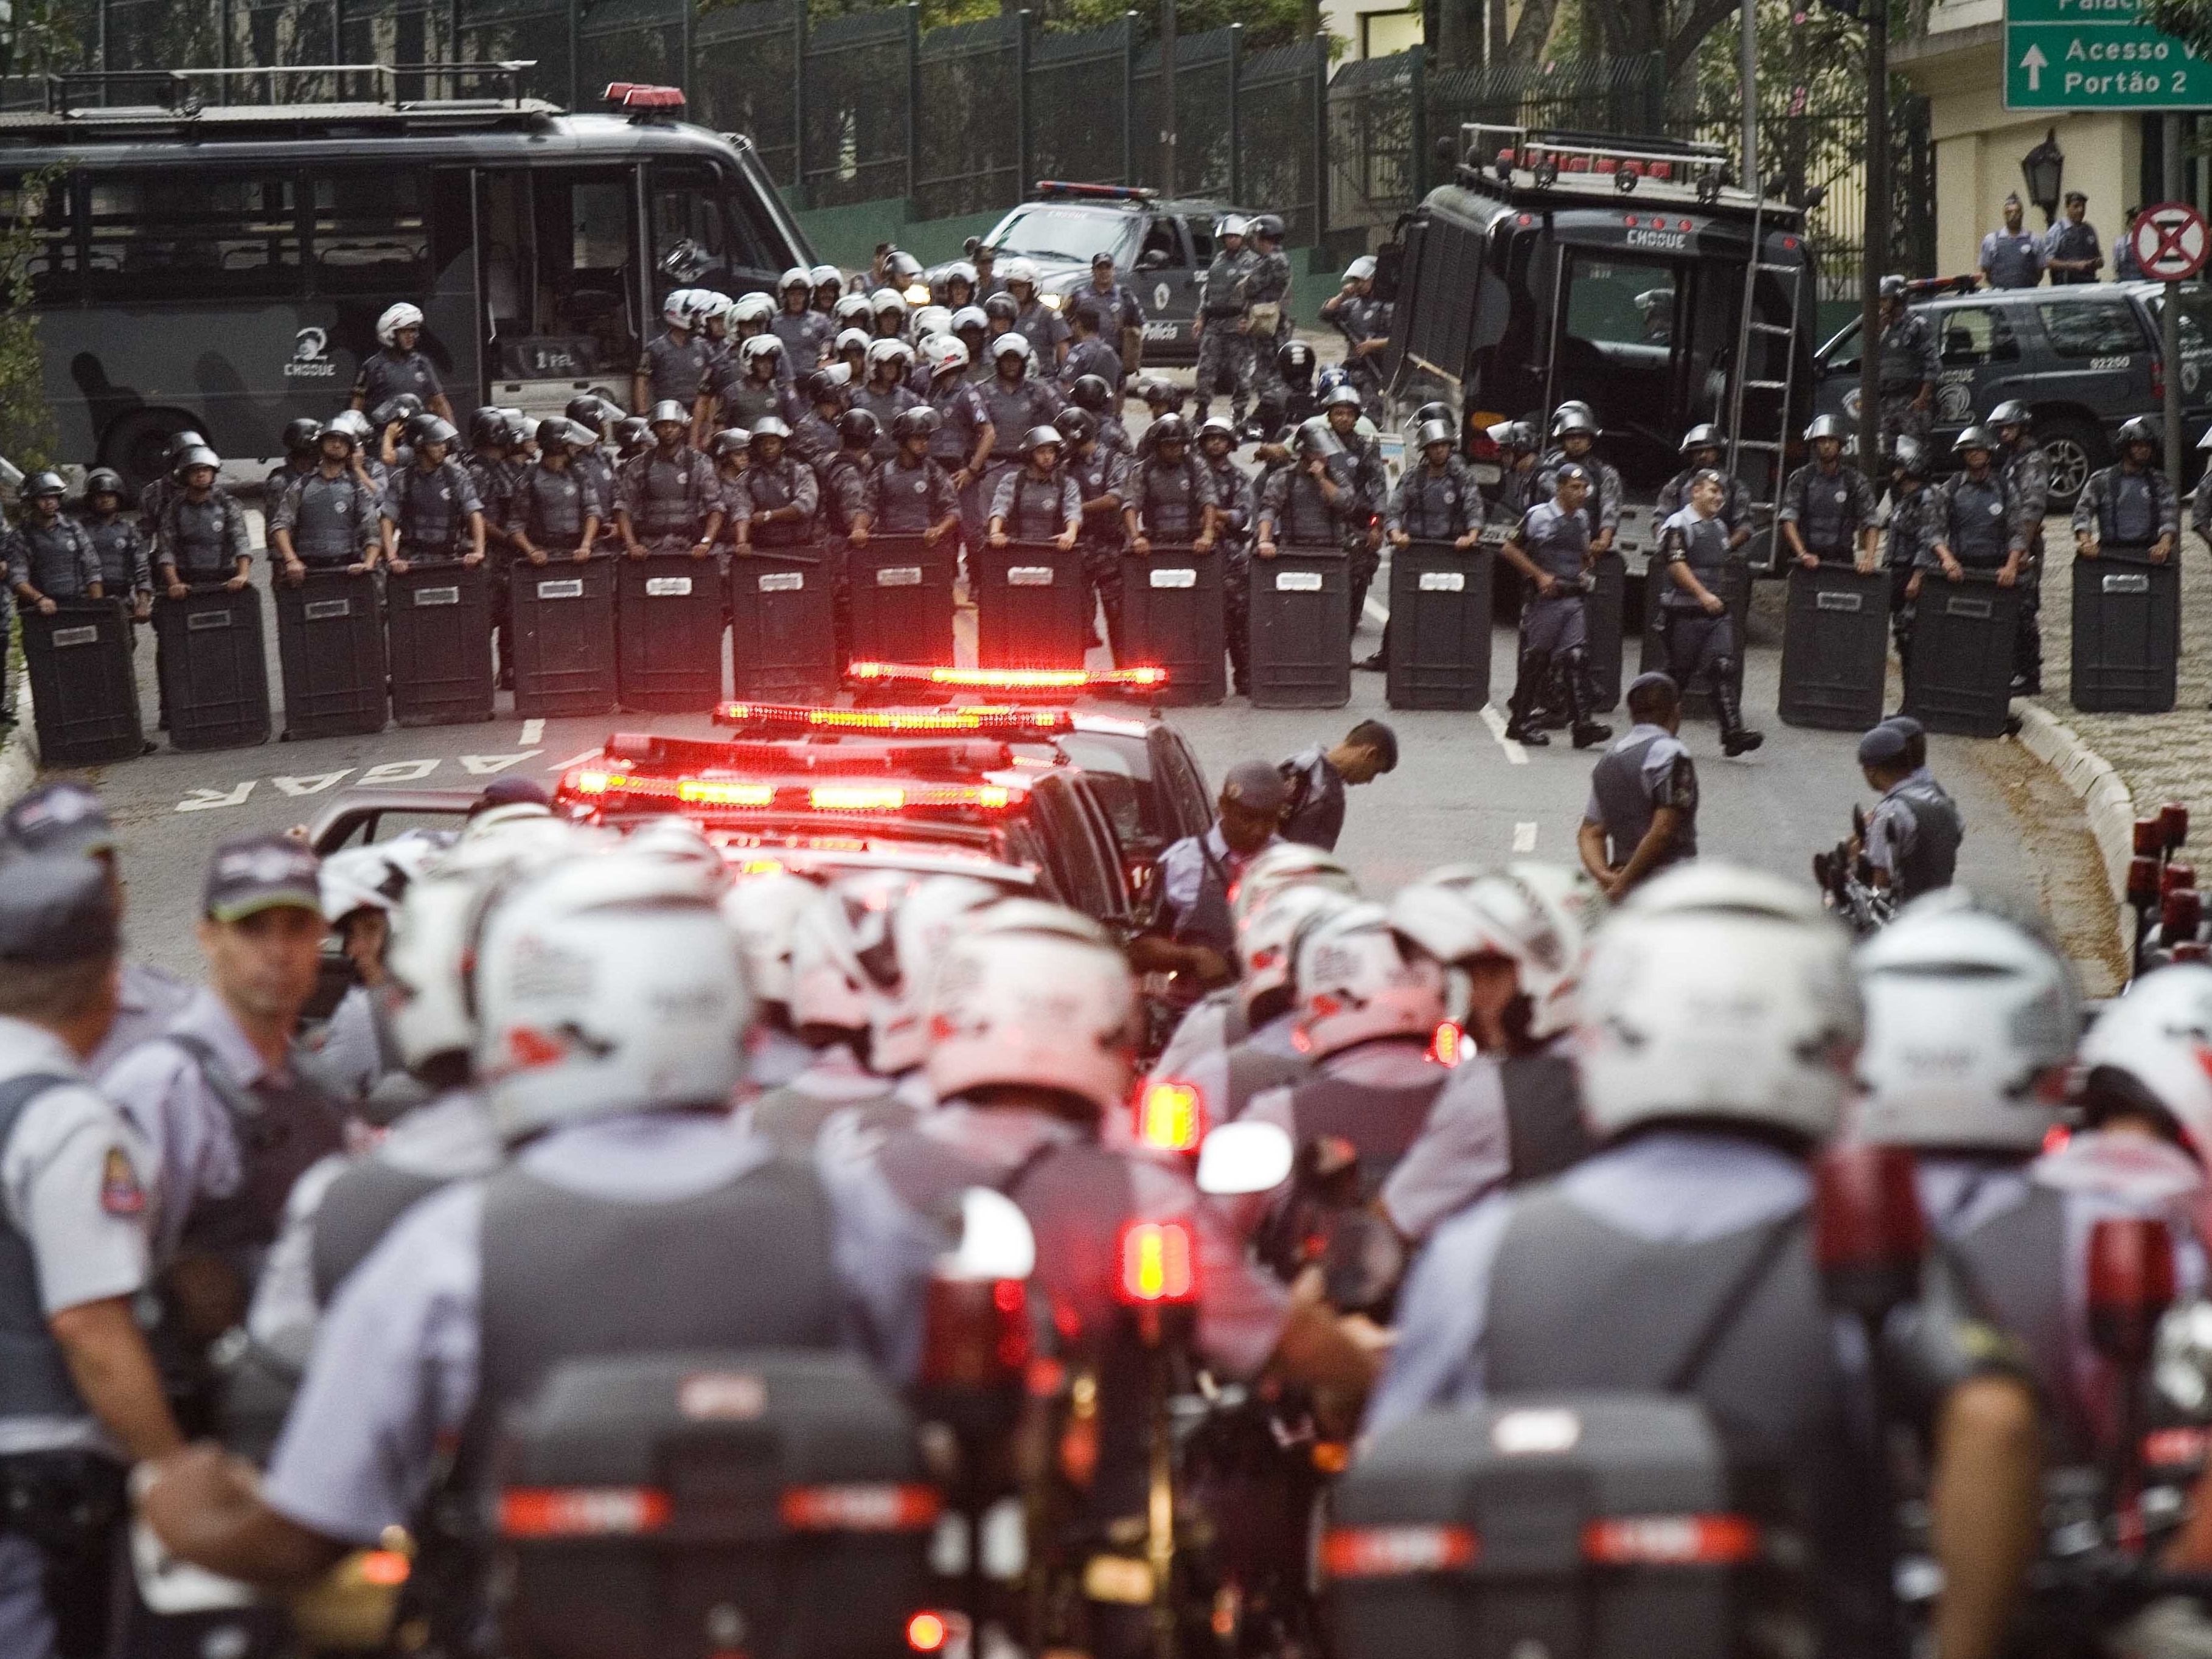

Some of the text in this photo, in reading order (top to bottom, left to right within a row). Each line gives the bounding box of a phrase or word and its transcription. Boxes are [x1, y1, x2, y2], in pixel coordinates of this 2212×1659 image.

[2065, 38, 2169, 60] Acesso
[2065, 71, 2187, 94] Portão 2
[1627, 229, 1686, 249] CHOQUE
[284, 363, 336, 376] CHOQUE
